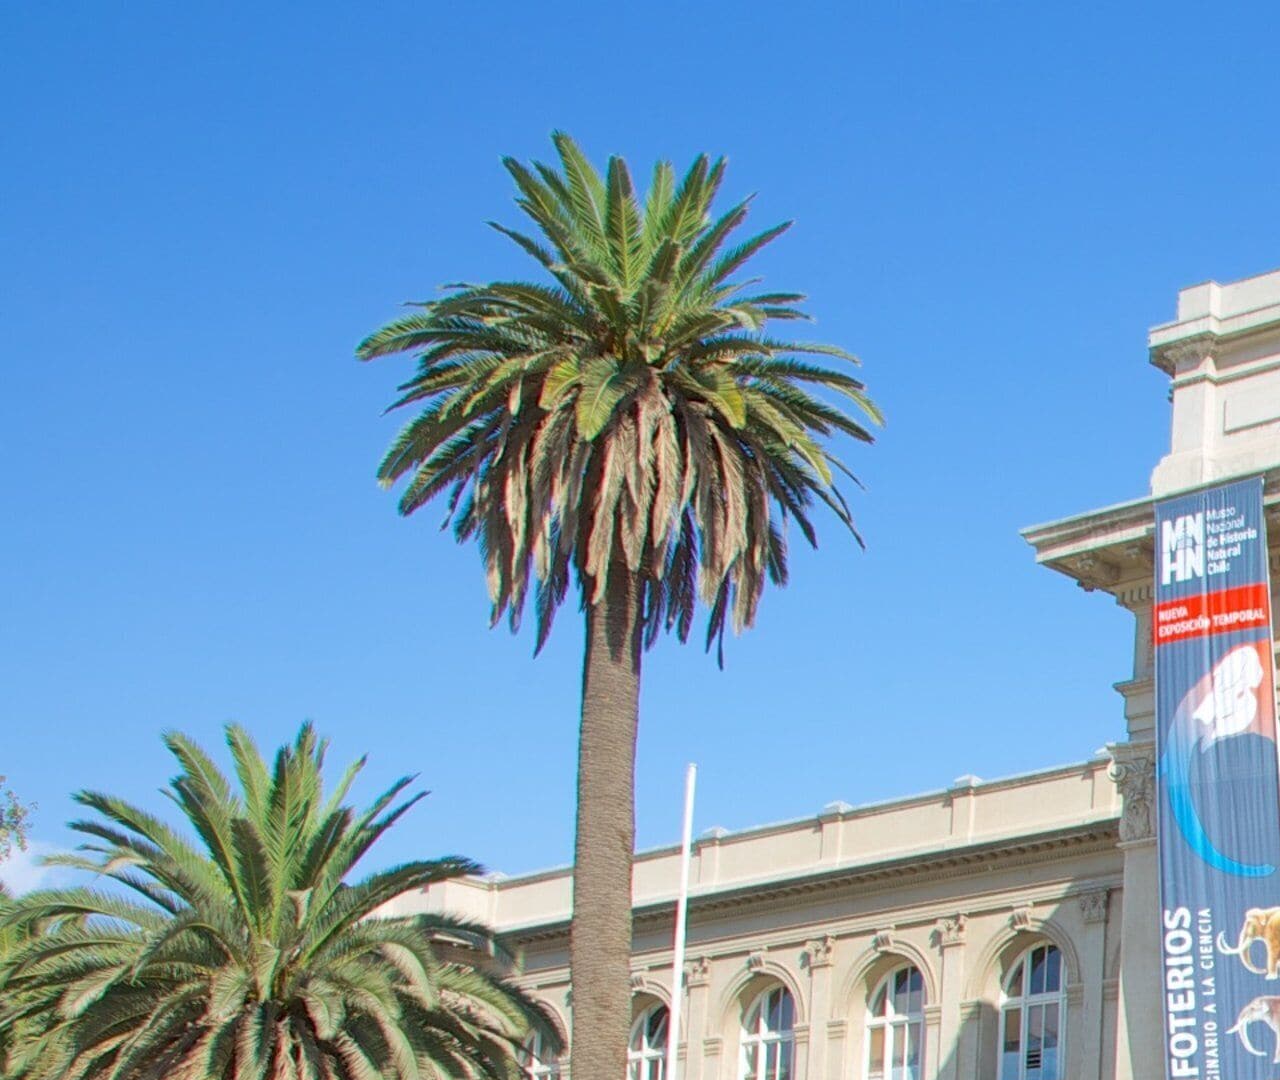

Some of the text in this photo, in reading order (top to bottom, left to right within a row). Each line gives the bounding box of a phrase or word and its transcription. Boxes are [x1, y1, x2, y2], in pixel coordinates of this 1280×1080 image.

[1206, 507, 1236, 520] Museo
[1162, 513, 1203, 551] MN
[1206, 515, 1245, 534] Nacional
[1220, 528, 1257, 545] Historia
[1207, 544, 1241, 560] Natural
[1162, 546, 1203, 585] HN
[1159, 607, 1188, 621] NUEVA
[1159, 609, 1264, 637] EXPOSICIÓN TEMPORAL
[1198, 908, 1213, 968] CIENCIA
[1202, 977, 1215, 995] LA
[1204, 1004, 1216, 1014] A
